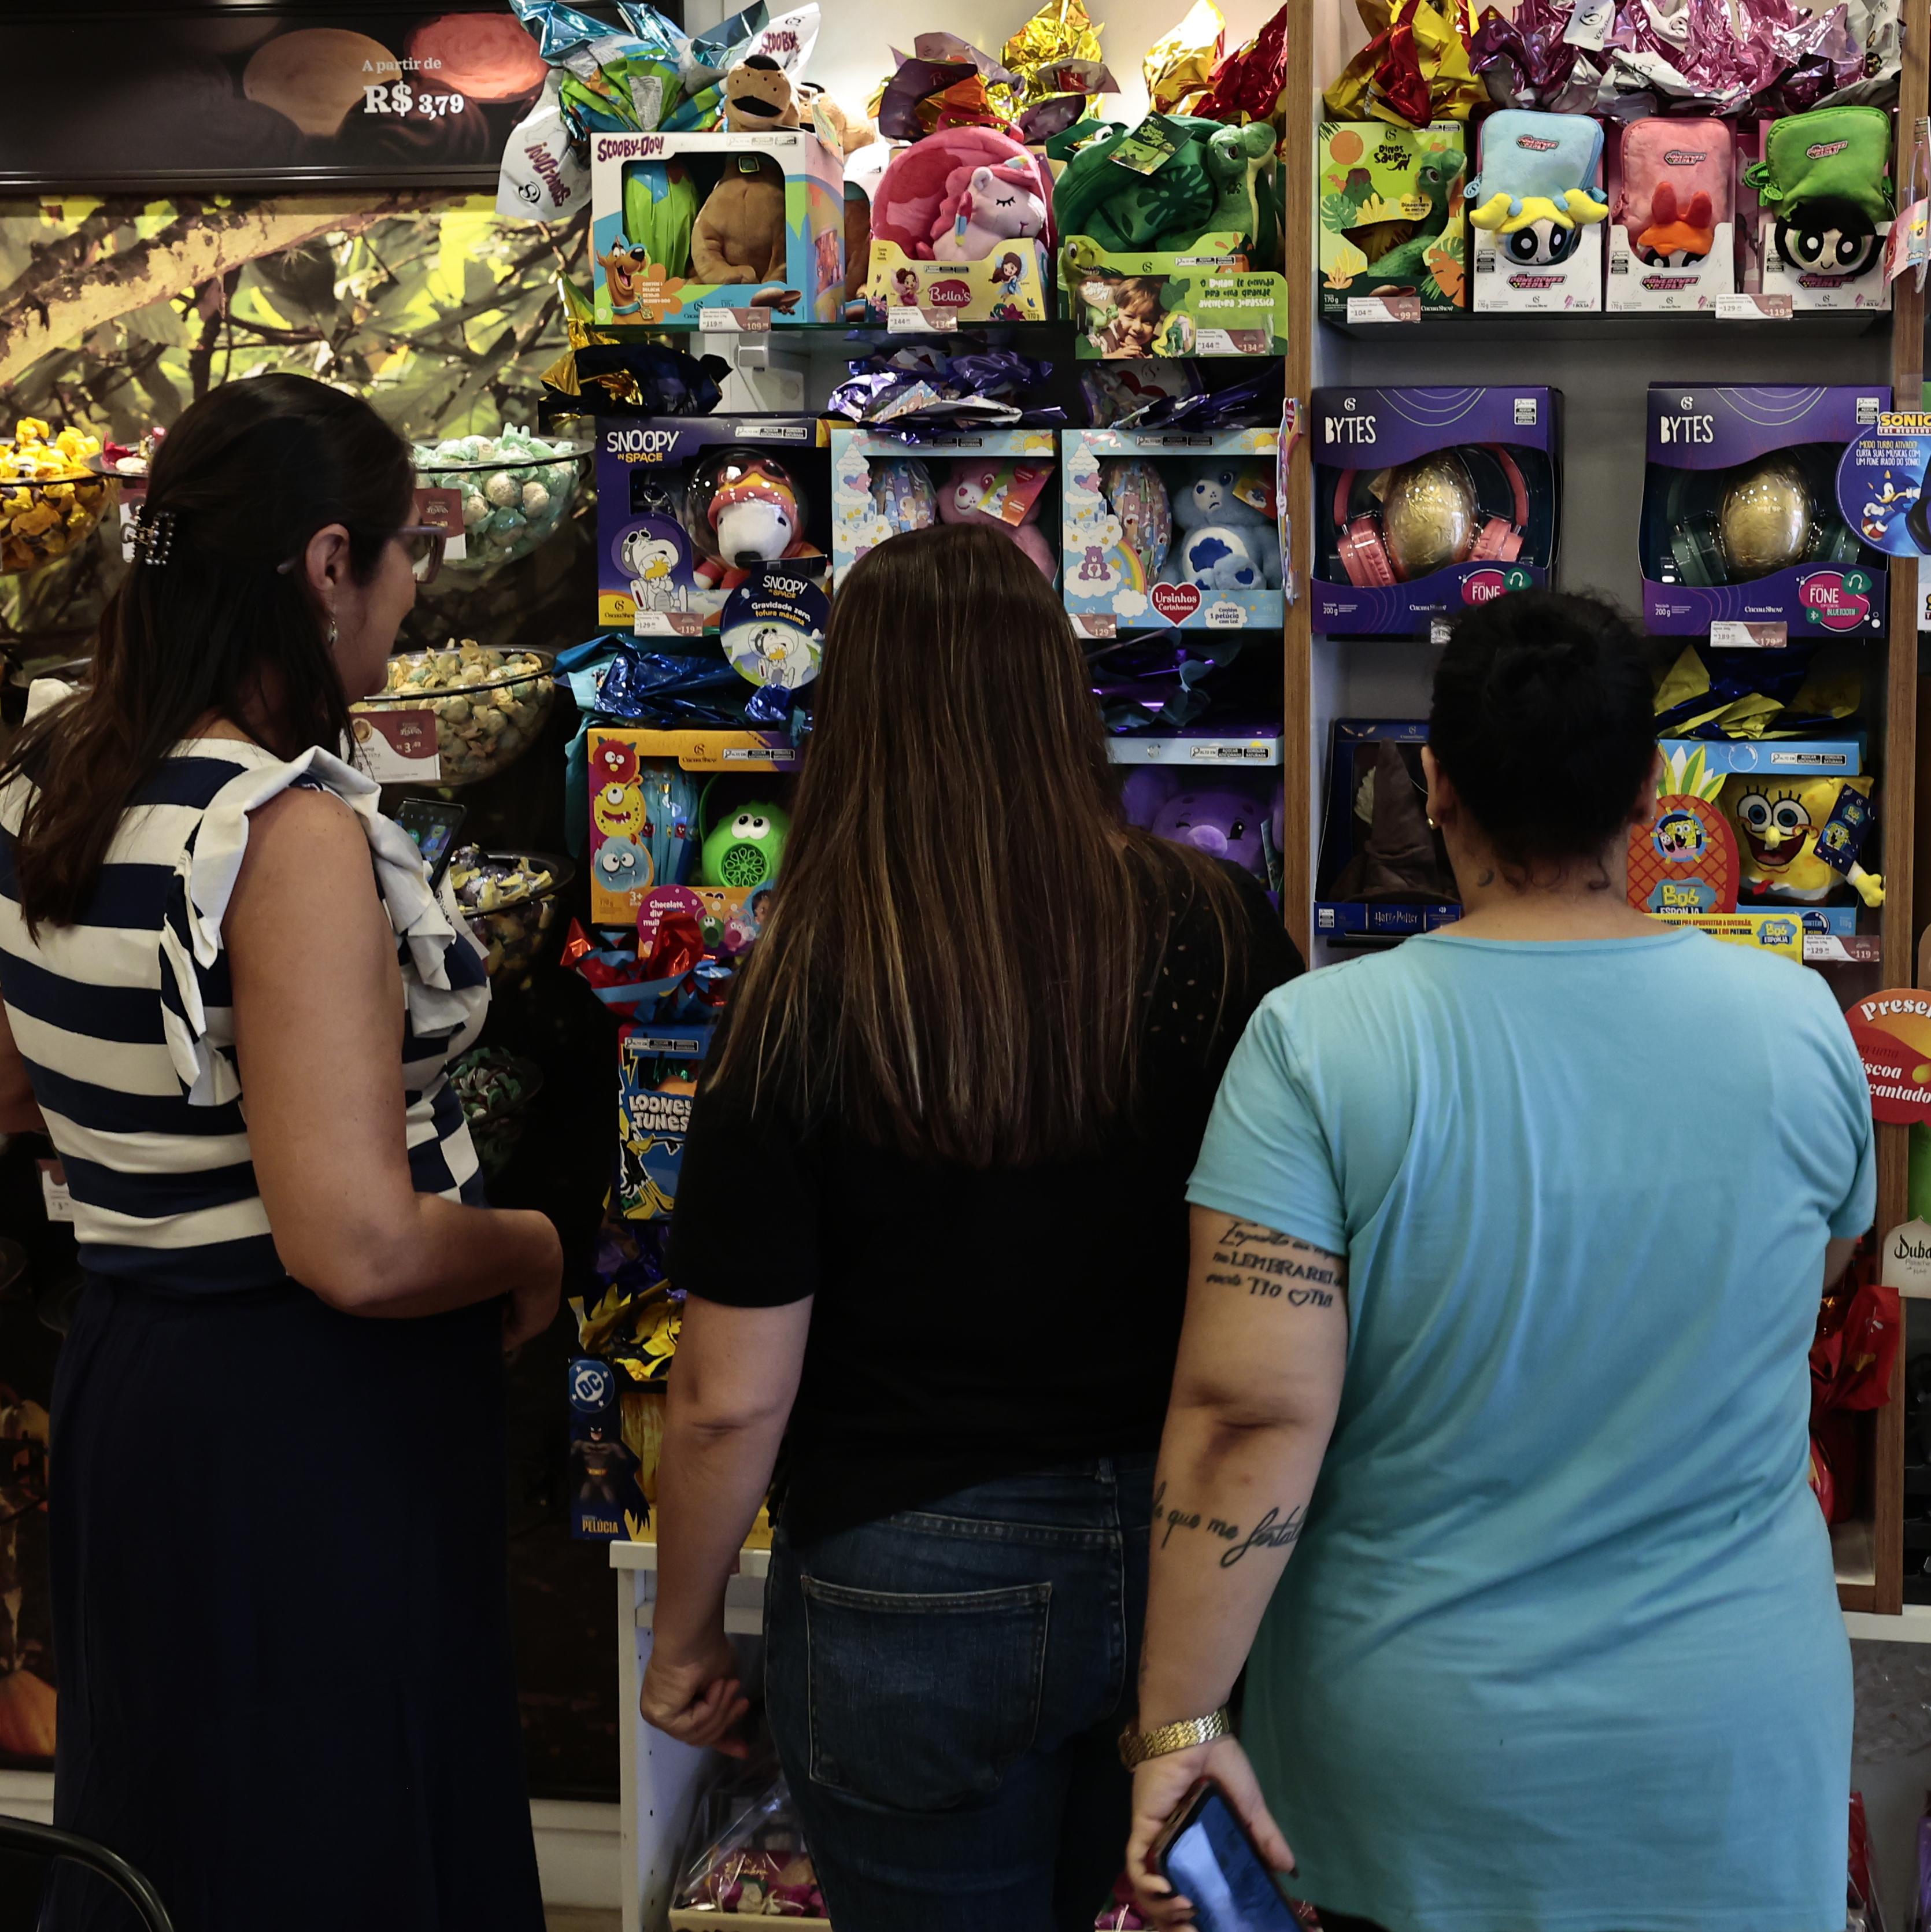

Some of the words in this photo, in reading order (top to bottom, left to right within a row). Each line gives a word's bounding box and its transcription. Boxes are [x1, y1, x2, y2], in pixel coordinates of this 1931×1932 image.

[362, 60, 373, 72] A
[376, 57, 421, 74] partir
[424, 57, 442, 69] de
[363, 80, 413, 117] R$
[419, 94, 464, 121] 3,79
[1325, 416, 1376, 443] BYTES
[1660, 415, 1714, 443] BYTES
[607, 430, 679, 452] SNOOPY
[625, 453, 663, 462] SPACE
[763, 575, 808, 595] SNOOPY
[773, 589, 797, 599] SPACE
[1155, 591, 1197, 604] Ursinhos
[1810, 588, 1838, 603] FONE
[752, 602, 792, 612] Gravidade
[1662, 884, 1700, 906] Bob
[1764, 935, 1788, 944] ESPONJA
[1766, 924, 1788, 937] Bob
[628, 1093, 692, 1116] LOONEY
[632, 1112, 689, 1132] TUNES
[1894, 1234, 1931, 1259] Duba
[578, 1373, 602, 1398] DC
[582, 1519, 619, 1534] PELÚCIA
